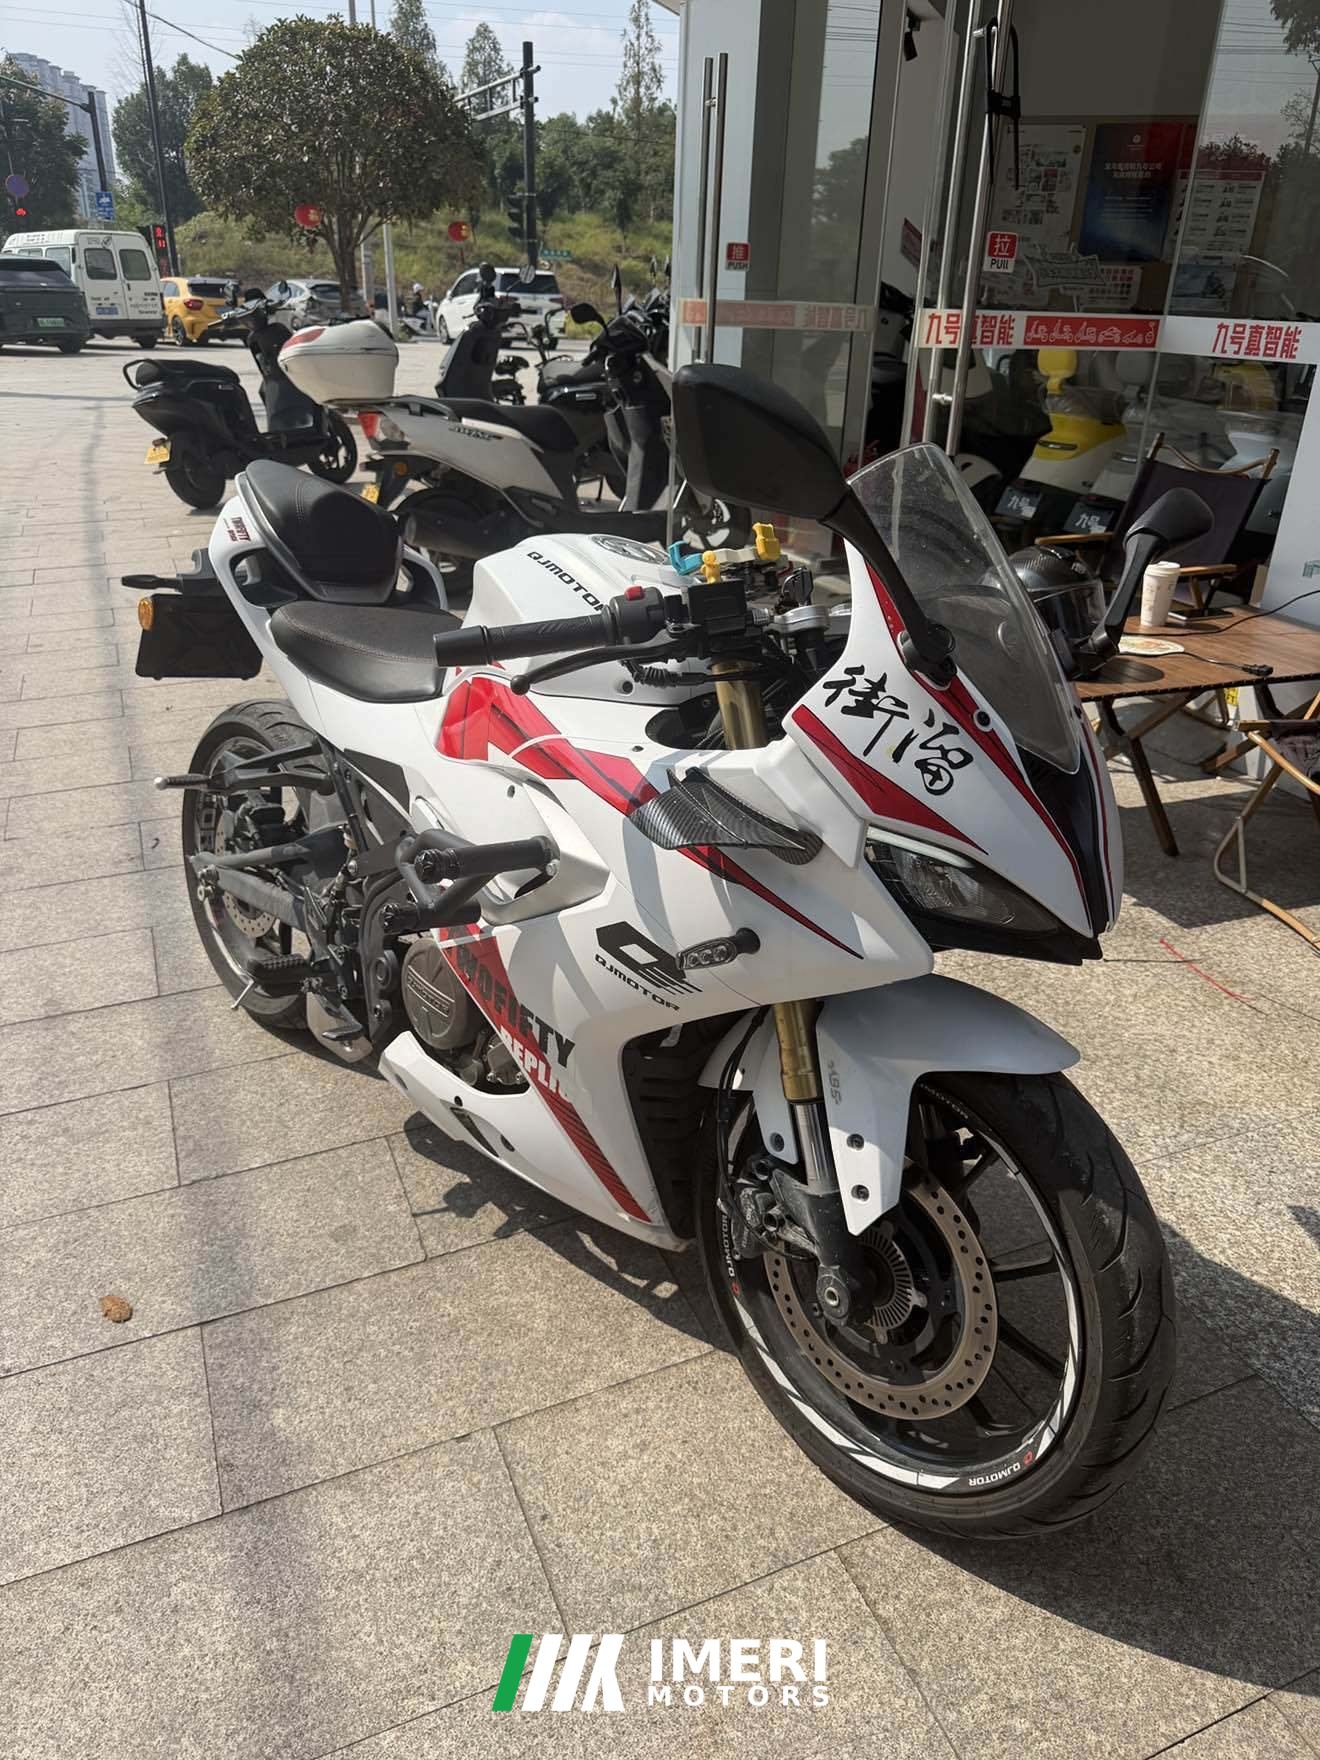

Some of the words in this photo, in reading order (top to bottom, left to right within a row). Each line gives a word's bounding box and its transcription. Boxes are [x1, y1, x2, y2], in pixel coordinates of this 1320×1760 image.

[992, 234, 1012, 256] 拉
[1212, 322, 1302, 360] 九号真智能
[594, 952, 681, 1012] QJMOTOR
[721, 1214, 736, 1278] QJMOTOR
[968, 1461, 1021, 1487] QJMOTOR
